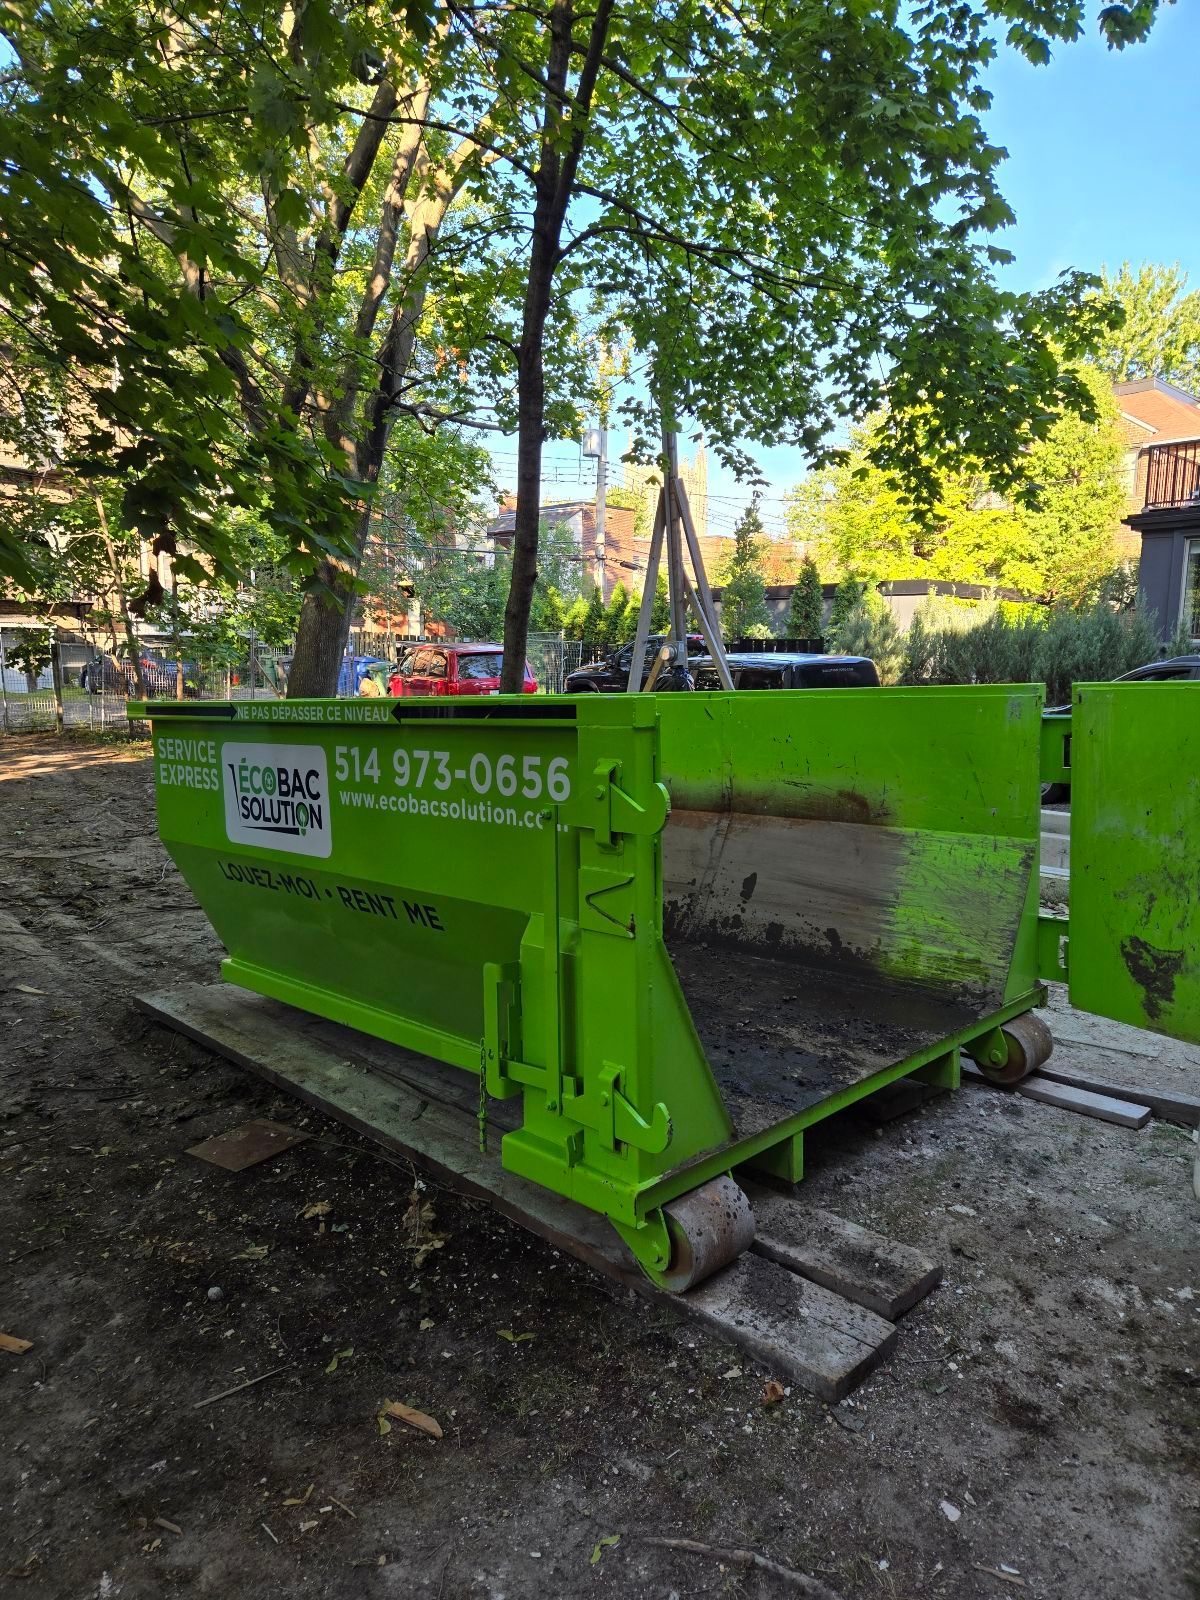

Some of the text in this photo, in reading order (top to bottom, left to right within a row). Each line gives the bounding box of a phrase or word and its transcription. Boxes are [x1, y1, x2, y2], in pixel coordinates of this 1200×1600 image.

[237, 703, 389, 722] NE PAS DÉPASSER CE NIVEAU
[158, 738, 217, 764] SERVICE
[159, 763, 219, 792] EXPRESS
[238, 757, 321, 801] ÉCOBAC
[335, 745, 571, 802] 514 973-0656
[241, 795, 323, 832] SOLUTION
[339, 790, 568, 833] www.ecobacsolution.c
[217, 860, 445, 931] LOUEZ-MOI RENT ME
